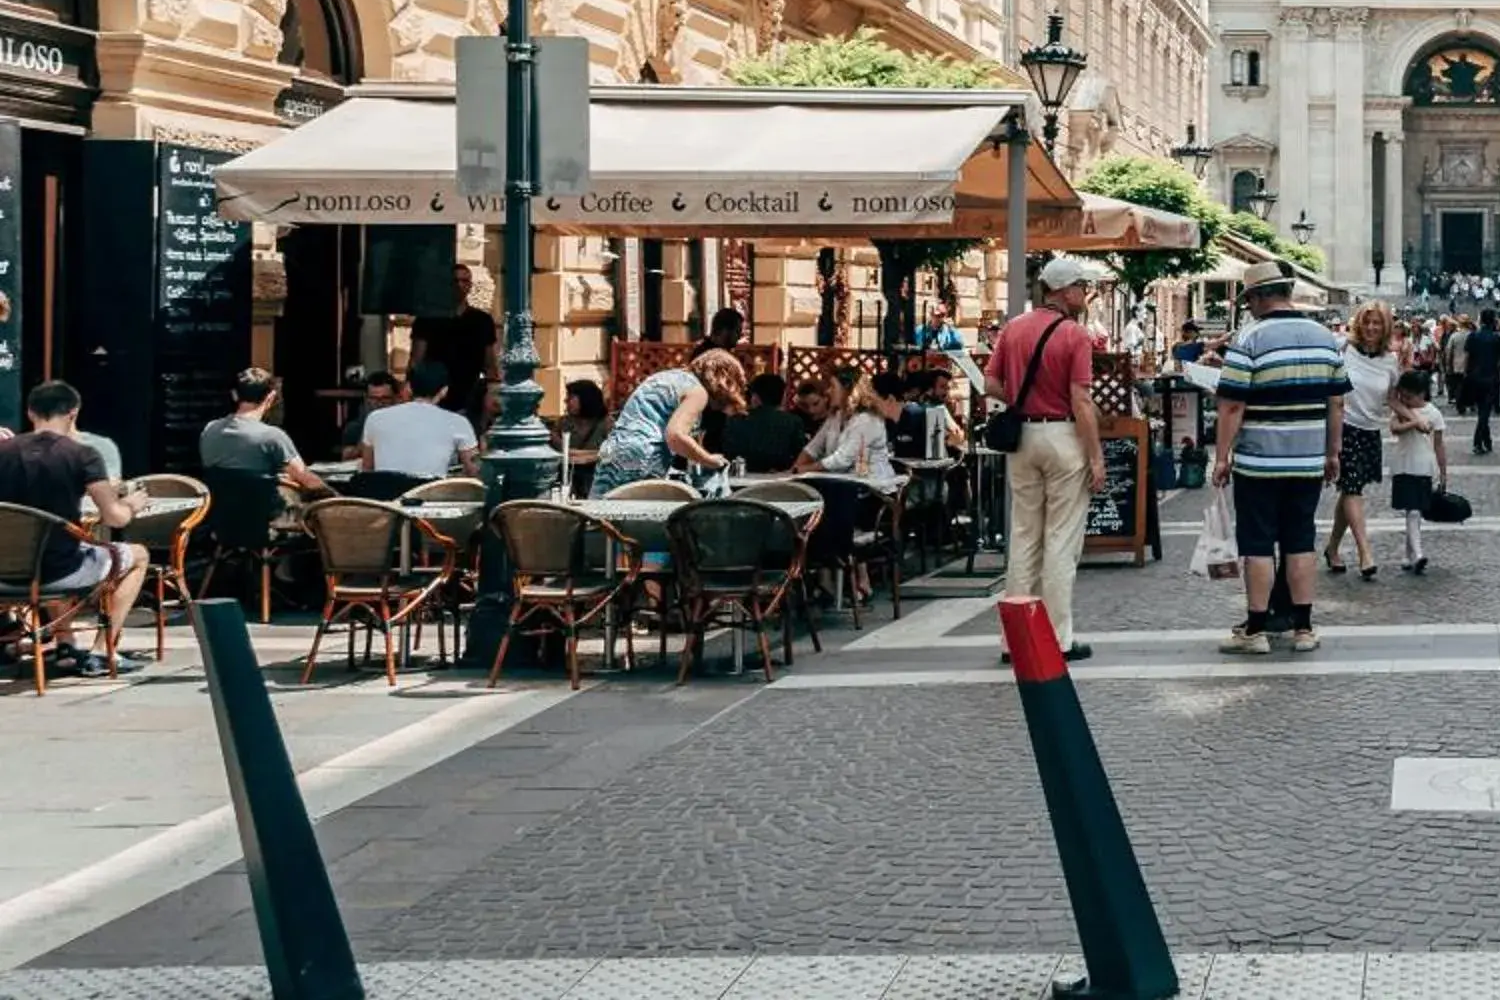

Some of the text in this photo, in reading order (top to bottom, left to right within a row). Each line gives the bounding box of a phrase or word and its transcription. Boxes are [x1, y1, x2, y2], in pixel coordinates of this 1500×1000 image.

[0, 37, 63, 75] LOSO
[580, 191, 653, 212] Coffee
[705, 190, 800, 212] Cocktail
